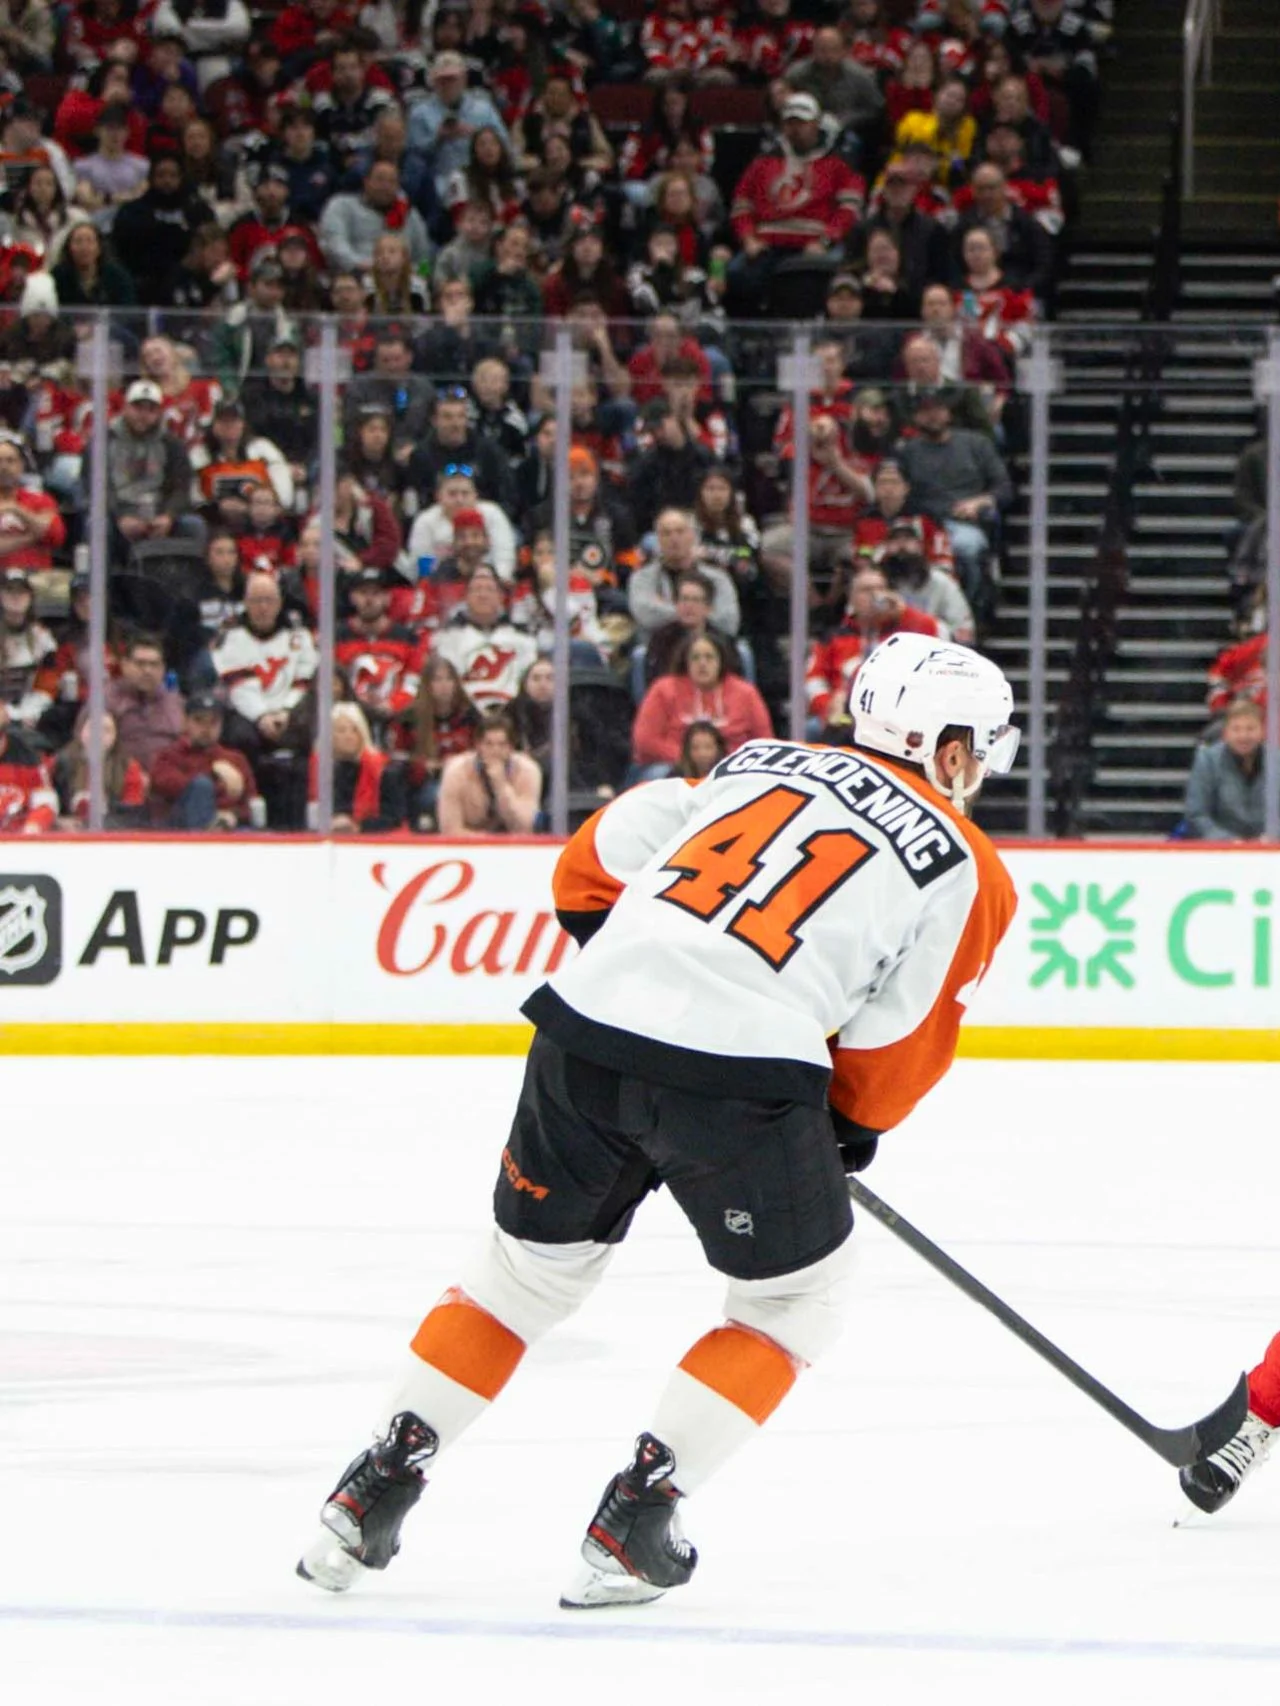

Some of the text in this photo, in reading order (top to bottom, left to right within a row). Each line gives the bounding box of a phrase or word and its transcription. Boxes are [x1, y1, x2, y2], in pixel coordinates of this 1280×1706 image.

[859, 688, 875, 715] 41
[726, 745, 951, 873] GLENDENING
[653, 783, 880, 974] 41
